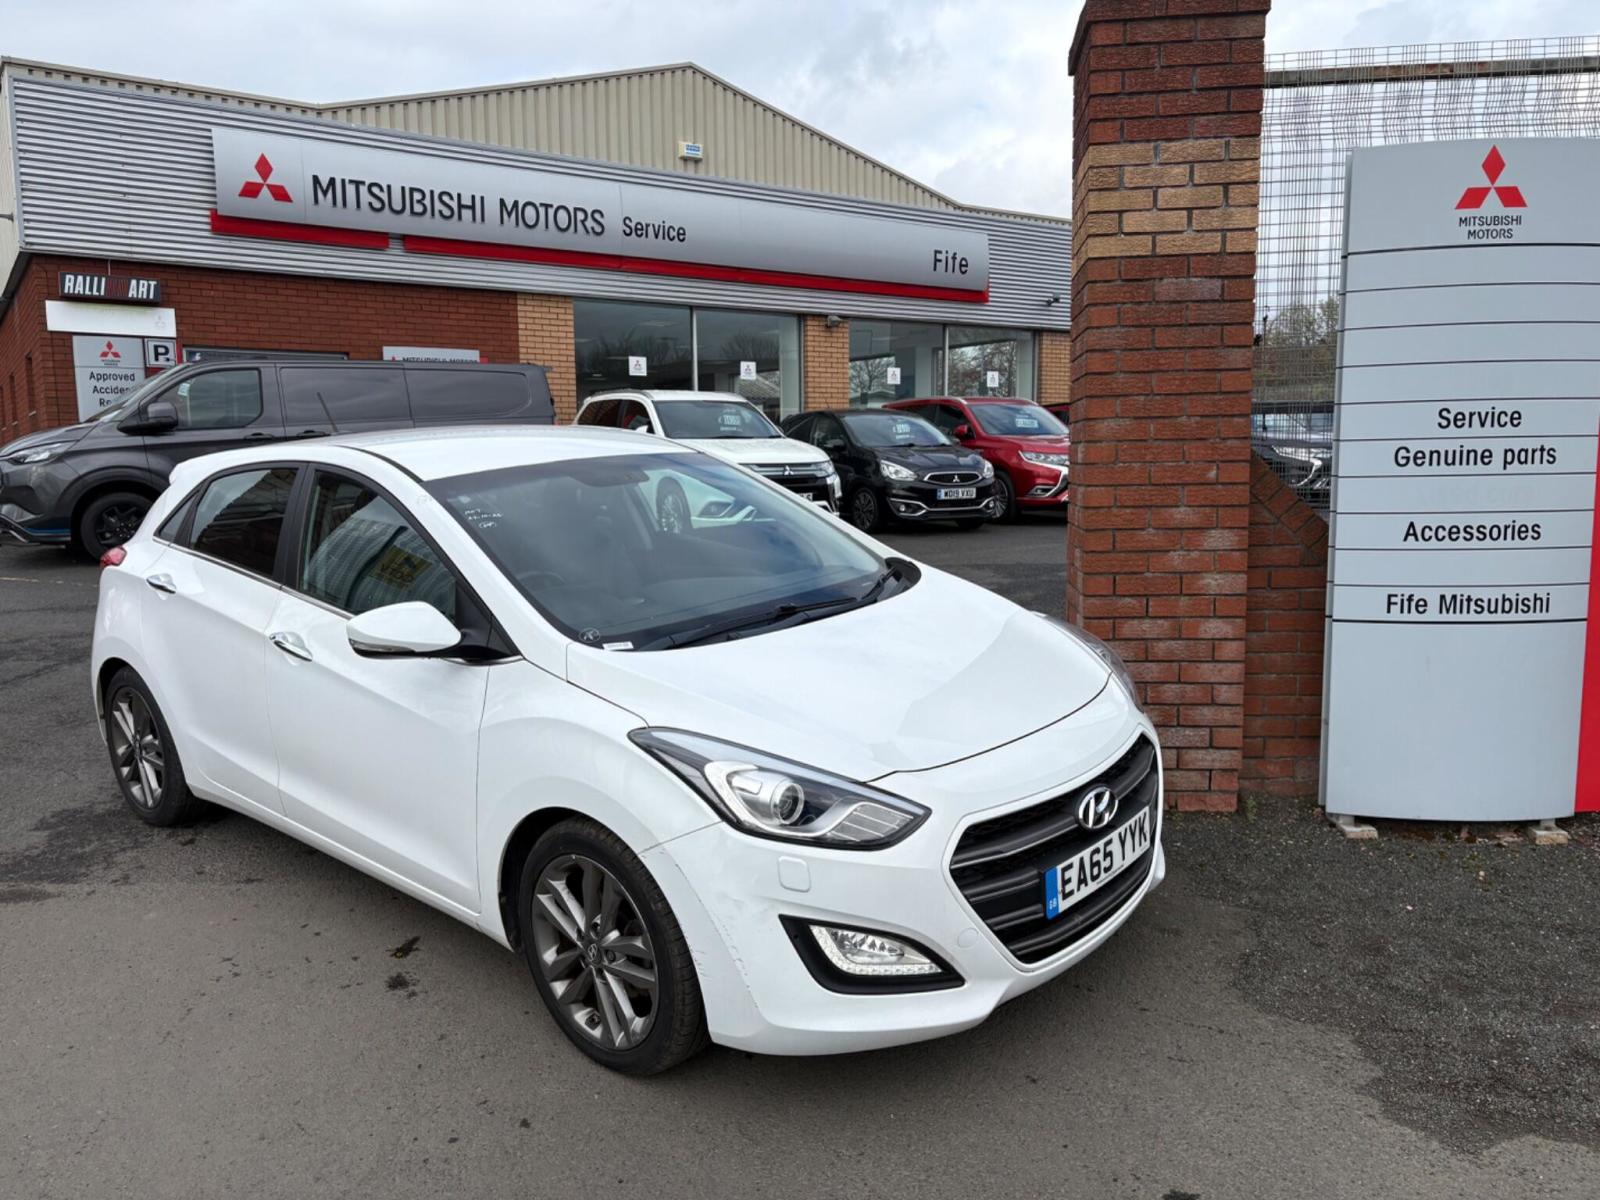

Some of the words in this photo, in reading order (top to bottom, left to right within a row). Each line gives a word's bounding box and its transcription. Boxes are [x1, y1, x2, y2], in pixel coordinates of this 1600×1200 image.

[312, 174, 486, 223] MITSUBISHI
[499, 198, 606, 237] MOTORS
[622, 215, 687, 243] Service
[932, 249, 969, 275] Fife
[1458, 214, 1522, 227] MITSUBISHI
[1467, 227, 1514, 240] MOTORS
[89, 371, 136, 381] Approved
[1437, 406, 1523, 429] Service
[1394, 444, 1493, 467] Genuine
[1502, 444, 1557, 471] parts
[1403, 520, 1542, 542] Accessories
[1386, 593, 1429, 615] Fife
[1439, 592, 1551, 615] Mitsubishi
[1061, 838, 1114, 901] EA65
[1118, 812, 1148, 862] YYK
